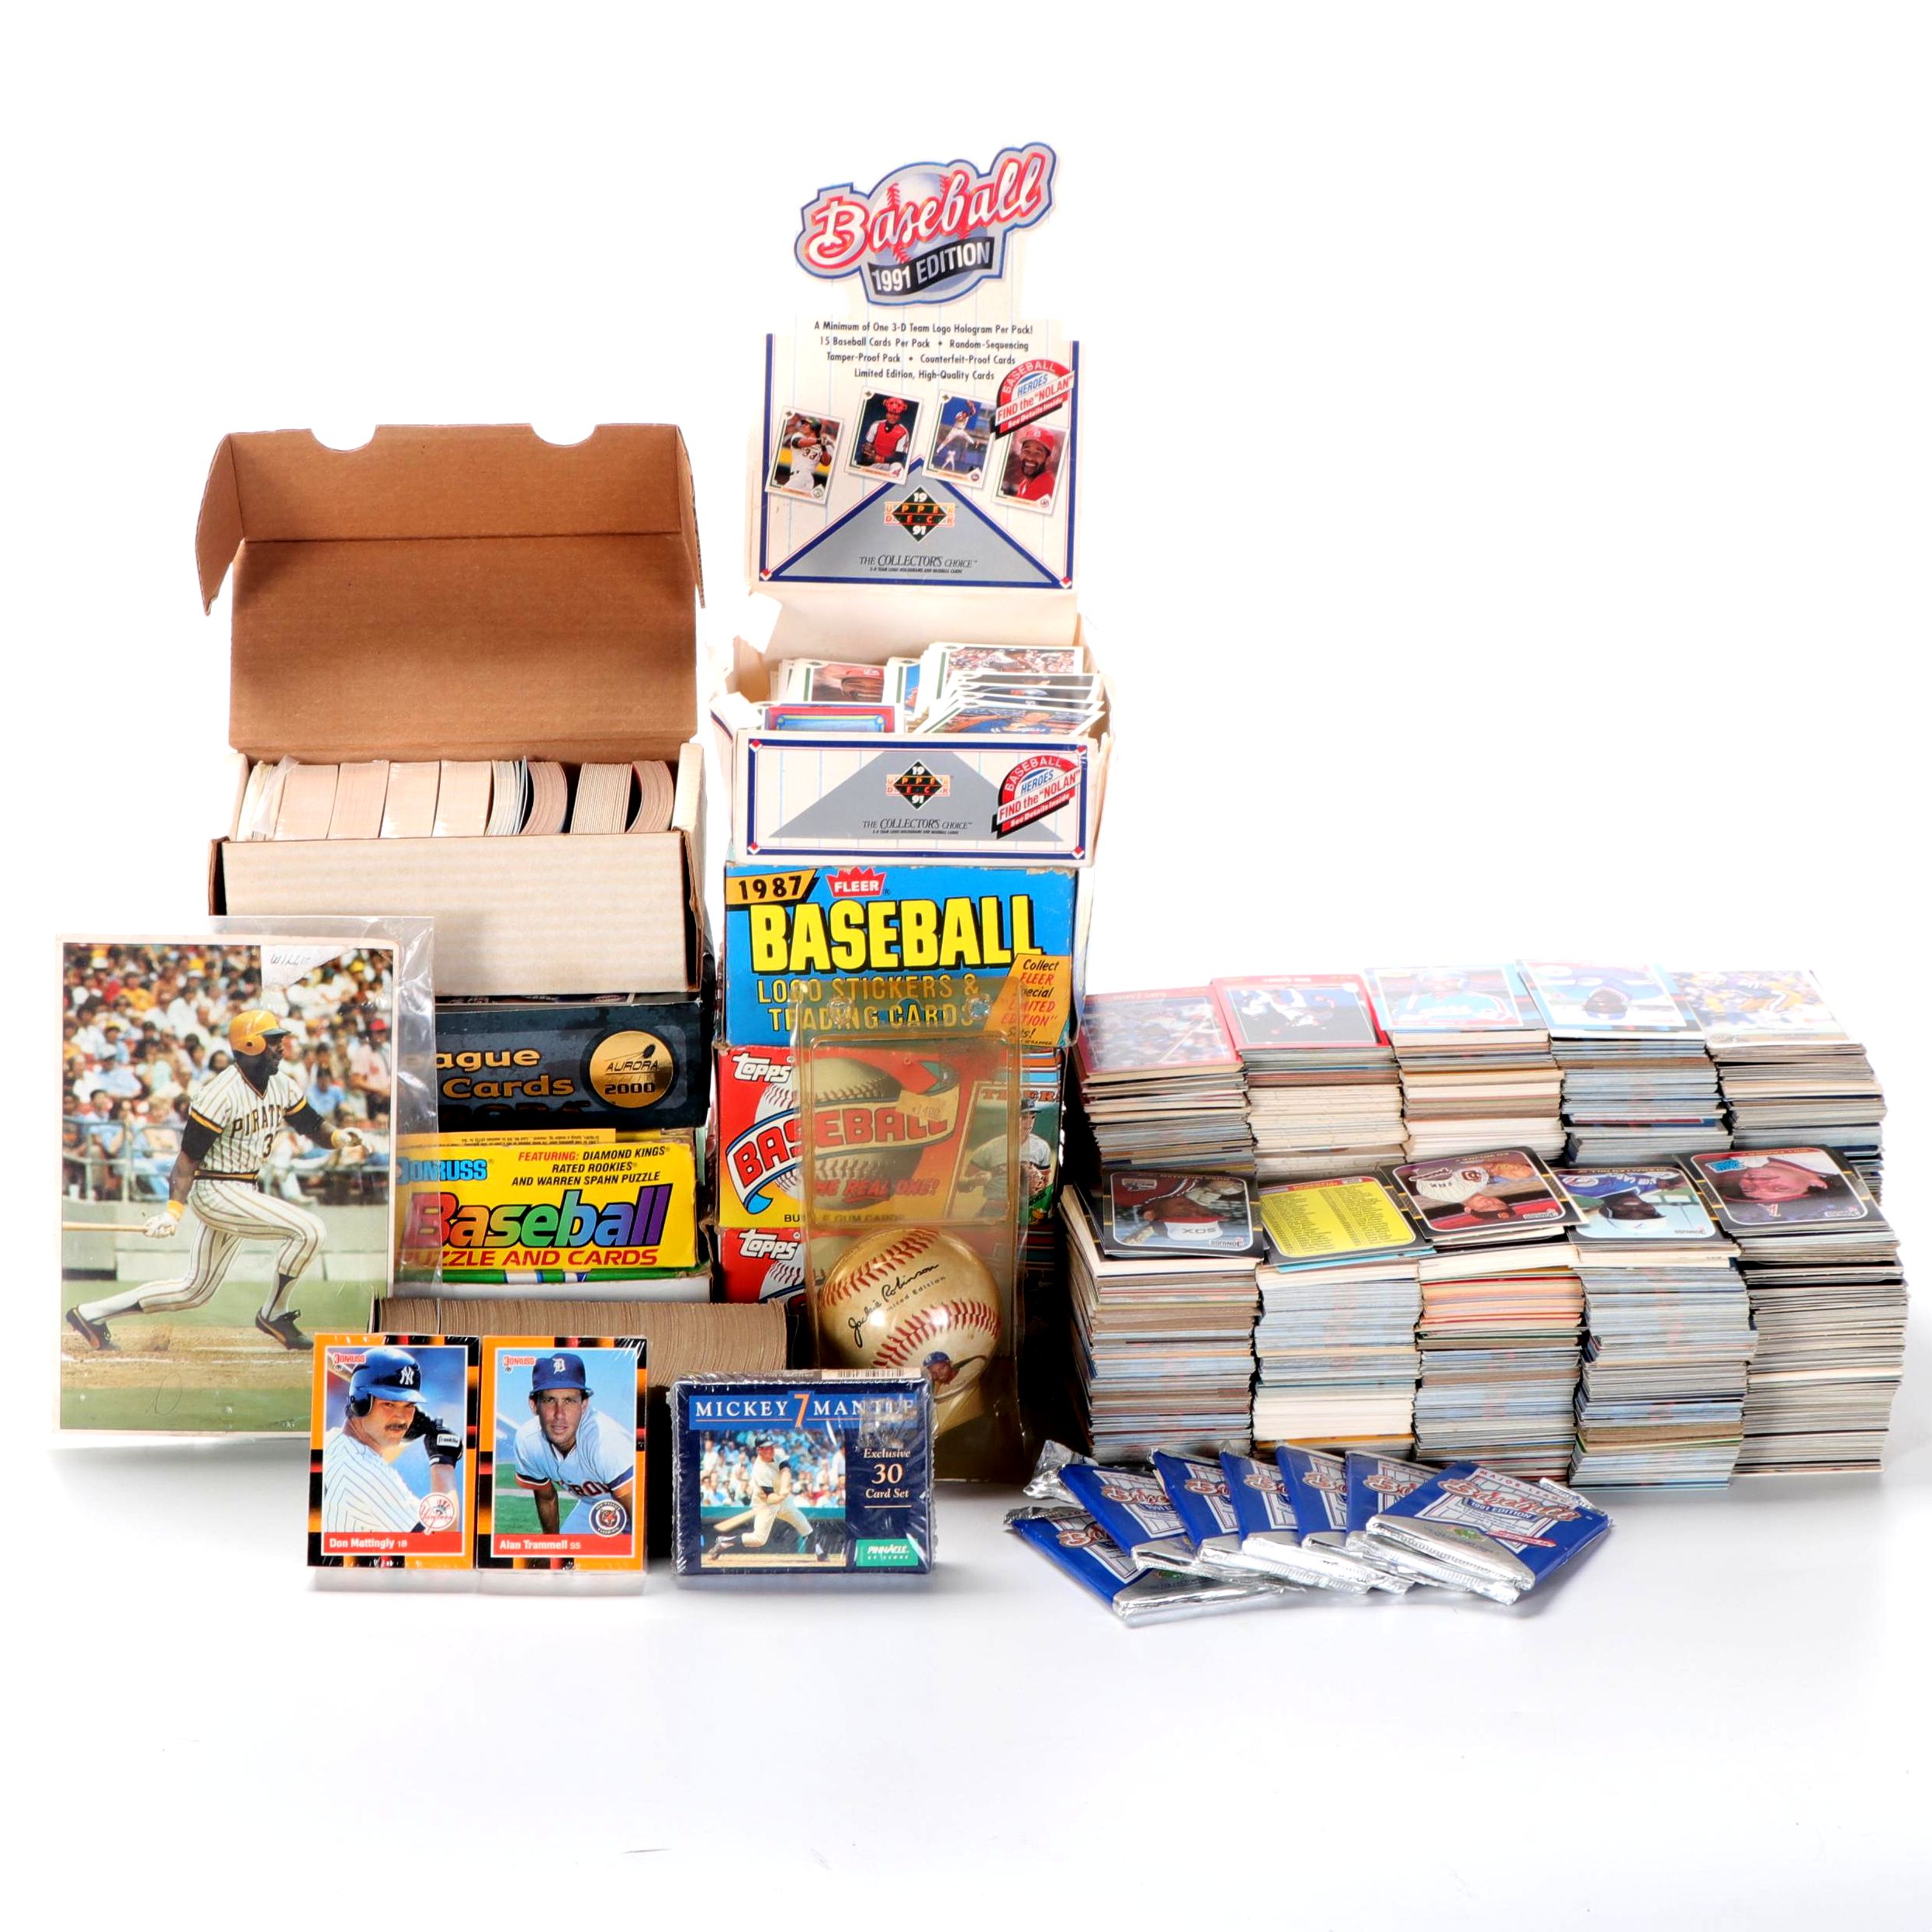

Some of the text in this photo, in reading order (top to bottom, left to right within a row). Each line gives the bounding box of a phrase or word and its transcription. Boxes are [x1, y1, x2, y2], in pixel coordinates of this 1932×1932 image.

[805, 152, 1045, 269] Baseball
[873, 242, 991, 293] 1991 EDITION
[822, 322, 859, 331] Minimum
[862, 322, 871, 331] of
[873, 323, 889, 332] One
[892, 323, 906, 332] 3-D
[909, 323, 930, 333] Team
[933, 324, 951, 334] Logo
[954, 324, 992, 335] Hologram
[995, 324, 1009, 334] Per
[1012, 324, 1033, 334] Pack!
[820, 337, 1029, 351] 15 Baseball Cards Per Pack Random-Sequencing
[827, 352, 1016, 365] Tamper-Proof Pack Counterfeit-Proof Cards
[854, 369, 995, 382] Limited Edition, High-Quality Cards
[1002, 360, 1056, 394] BASEBALL
[1017, 373, 1048, 397] HEROES
[997, 403, 1018, 422] FIND
[1020, 396, 1034, 411] the
[913, 492, 928, 502] 19
[885, 504, 955, 514] UPPER
[885, 515, 954, 524] DECK
[912, 525, 927, 535] 91
[859, 554, 972, 568] THE COLLECTOR'S CHOICE
[912, 766, 925, 775] 19
[1005, 757, 1062, 791] BASEBALL
[1021, 769, 1054, 795] HEROES
[912, 795, 925, 804] 91
[999, 801, 1022, 820] FIND
[1023, 794, 1039, 809] the
[863, 818, 968, 829] THE COLLECTOR'S CHOICE
[738, 875, 804, 901] 1987
[834, 879, 880, 893] FLEER
[750, 895, 1043, 972] BASEBALL
[1023, 959, 1060, 971] Collect
[1020, 972, 1055, 985] FLEER
[757, 973, 980, 1004] LOGO STICKERS &
[888, 1002, 975, 1030] CARDS
[435, 1048, 541, 1070] ague
[604, 1058, 659, 1073] AURORA
[442, 1074, 575, 1099] Cards
[604, 1081, 656, 1096] 2000
[518, 1151, 580, 1162] FEATURING:
[582, 1148, 632, 1162] DIAMOND
[733, 1106, 949, 1190] BASEBALL
[552, 1162, 632, 1173] RATED ROOKIES
[511, 1171, 661, 1186] AND WARREN SPAHN PUZZLE
[843, 1178, 890, 1196] REAL
[895, 1177, 940, 1196] ONE!
[400, 1183, 674, 1248] Baseball
[500, 1248, 562, 1266] AND
[566, 1248, 660, 1266] CARDS
[912, 1276, 947, 1297] Edition
[847, 1263, 940, 1349] Jackie Robinson
[334, 1353, 366, 1365] DONRUSS
[695, 1400, 789, 1418] MICKEY
[793, 1393, 810, 1428] 7
[863, 1448, 912, 1460] Exclusive
[871, 1463, 904, 1484] 30
[1479, 1470, 1521, 1488] MAJOR
[865, 1487, 910, 1500] Card Set
[1470, 1500, 1533, 1519] 1991 EDITION
[329, 1538, 408, 1549] Don Mattingly 1B
[500, 1540, 521, 1550] Alan
[523, 1539, 568, 1550] Trammell
